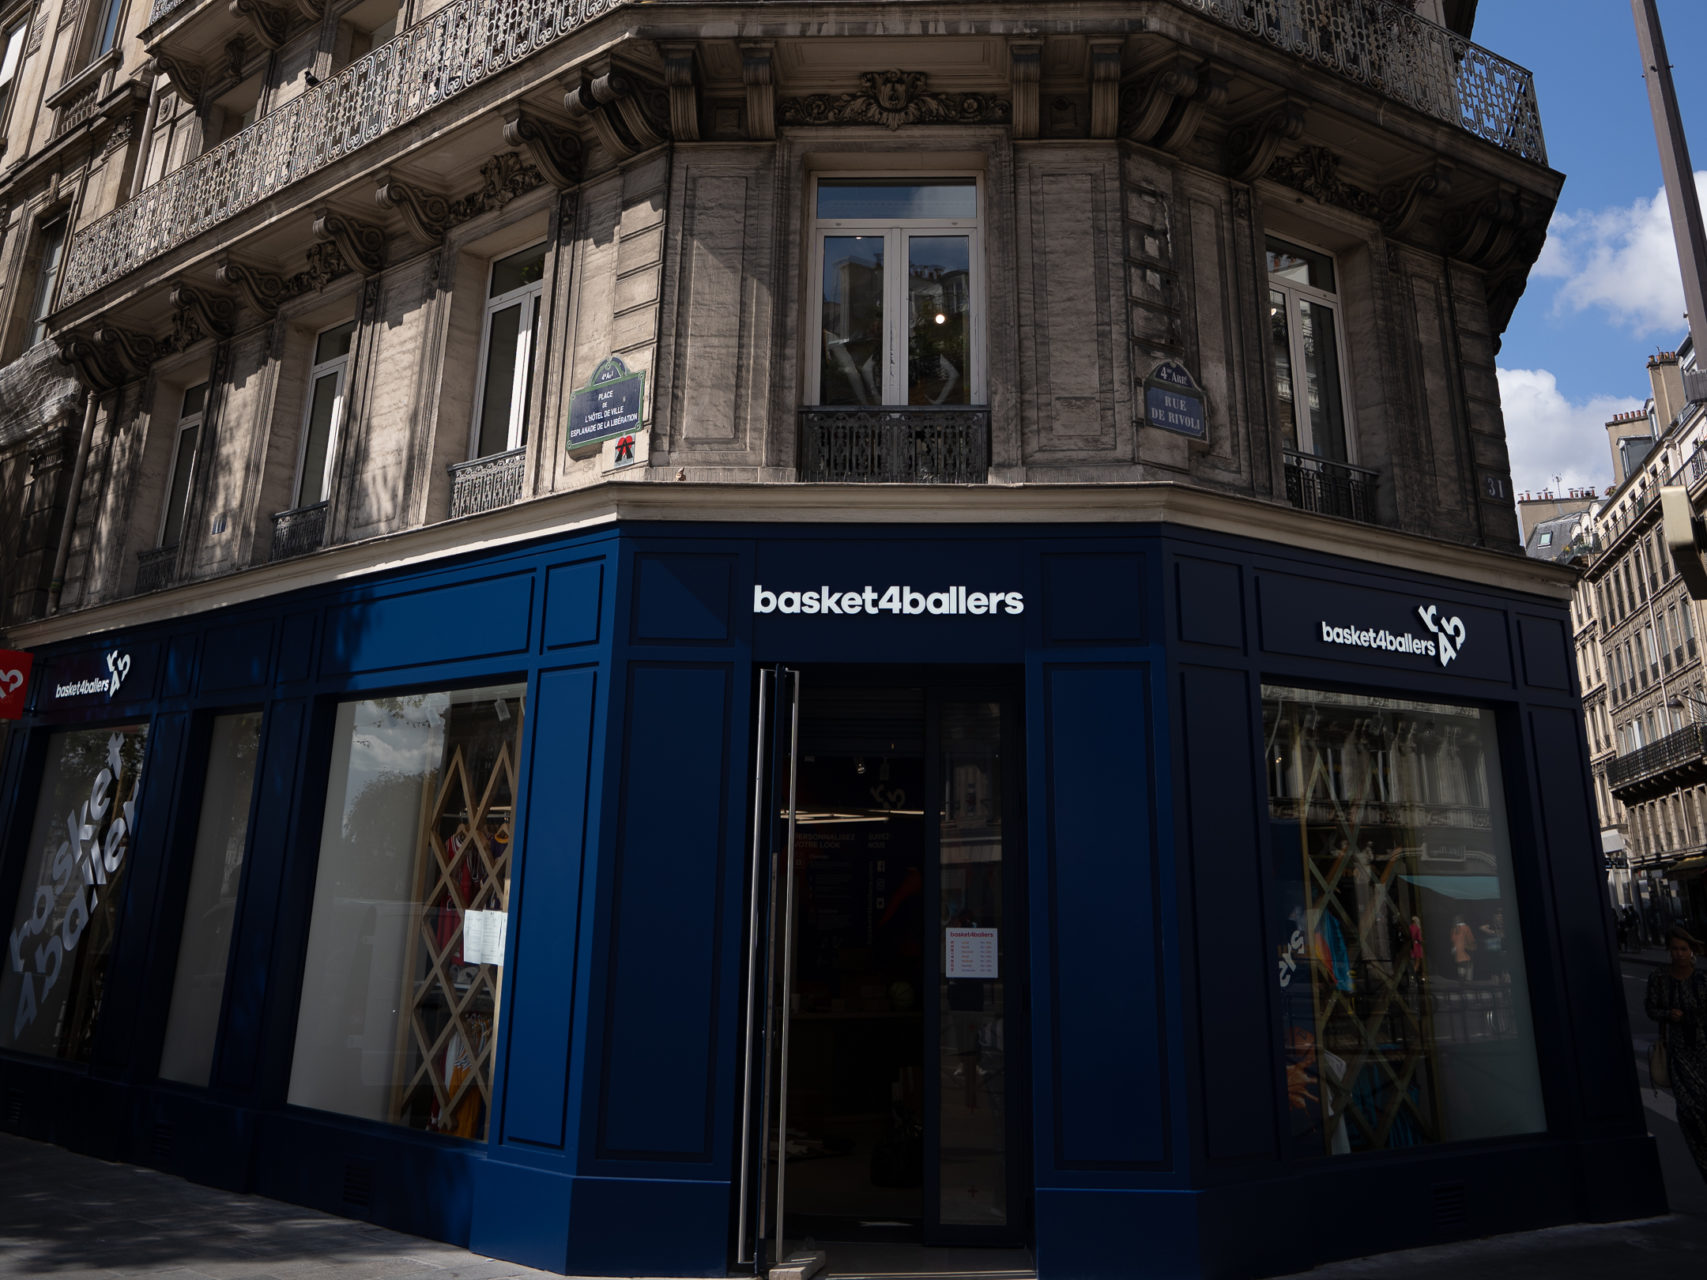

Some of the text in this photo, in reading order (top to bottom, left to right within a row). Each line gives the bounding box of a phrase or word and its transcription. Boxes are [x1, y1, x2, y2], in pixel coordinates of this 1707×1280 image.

[598, 391, 613, 400] PLACE
[1165, 396, 1186, 411] RUE
[611, 406, 624, 414] VILLE
[1151, 408, 1200, 429] DE RIVOLI
[571, 413, 637, 437] ESPLANADE DE LA LIBÉRATION
[1487, 477, 1504, 499] 31
[753, 585, 1025, 615] basket4ballers
[1321, 620, 1436, 657] basket4ballers
[55, 677, 110, 699] basket4ballers
